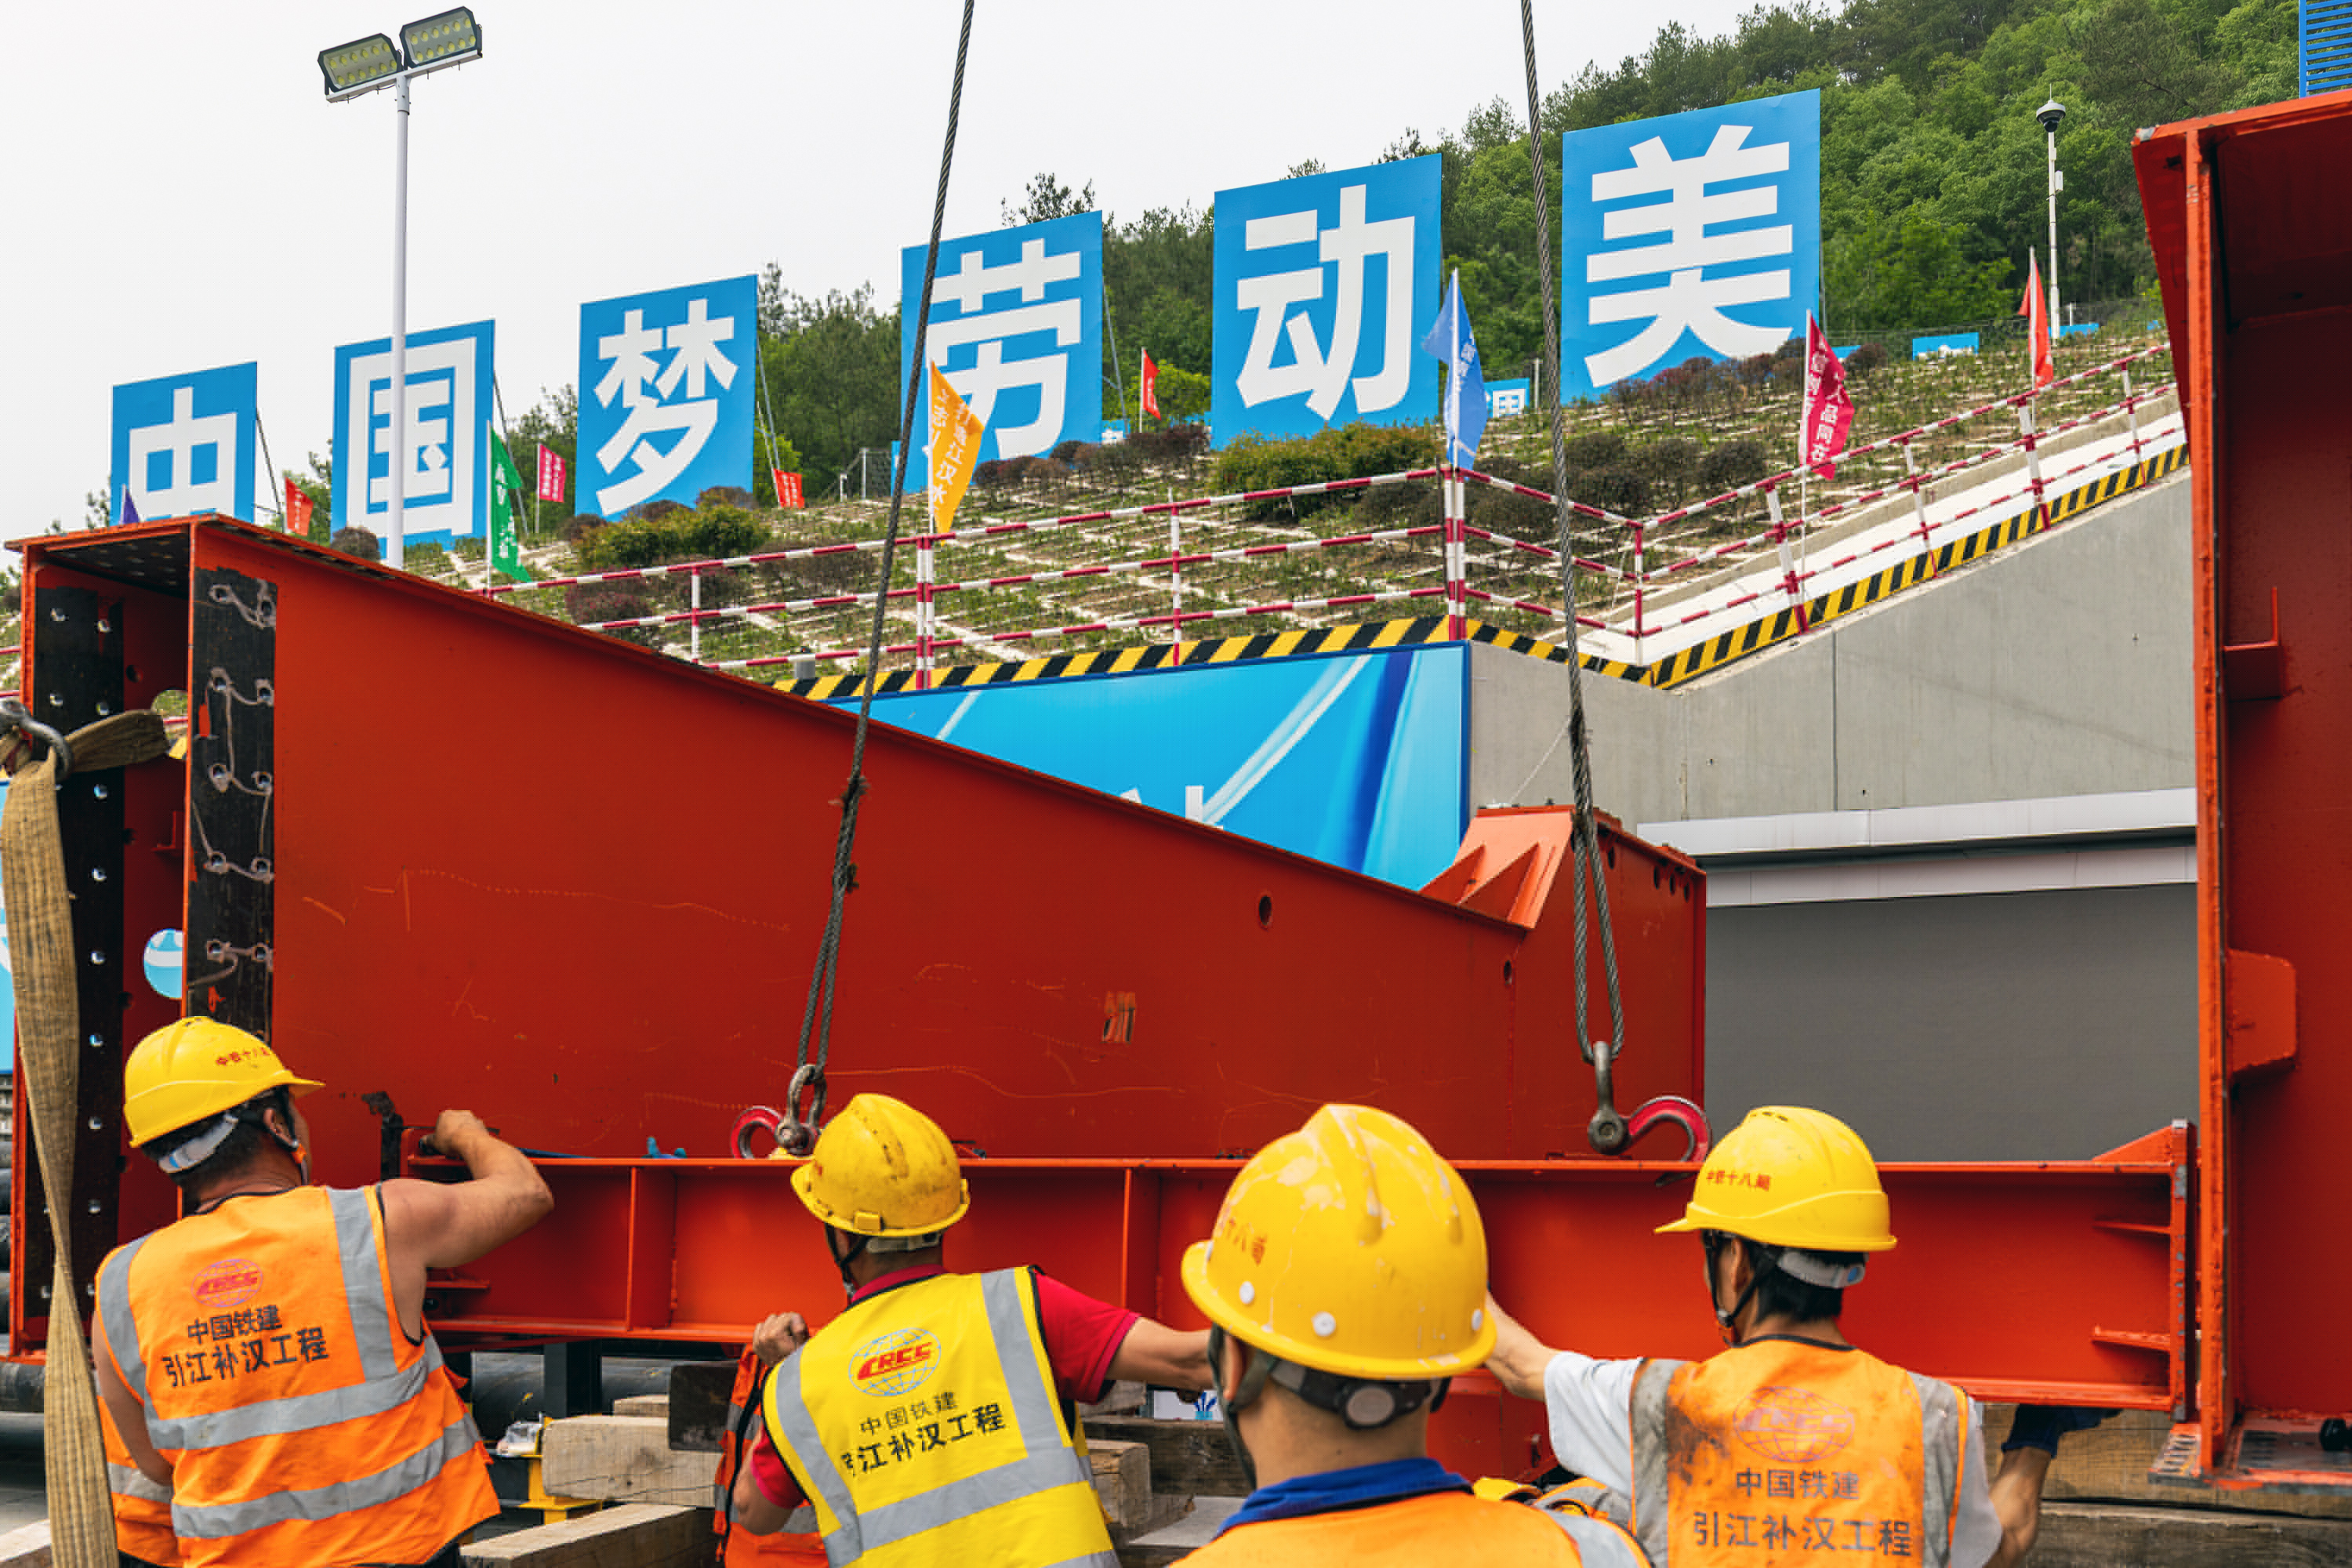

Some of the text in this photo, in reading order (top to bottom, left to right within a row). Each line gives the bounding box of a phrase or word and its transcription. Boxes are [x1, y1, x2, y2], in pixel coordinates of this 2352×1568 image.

[187, 1304, 283, 1345] 中国铁建
[162, 1327, 329, 1388] 引江补汉工程
[857, 1342, 933, 1381] CRCC
[859, 1392, 958, 1436] 中国铁建
[1739, 1406, 1853, 1434] CRCC
[1736, 1467, 1860, 1499] 中国铁建
[1693, 1512, 1911, 1556] 引江补汉工程
